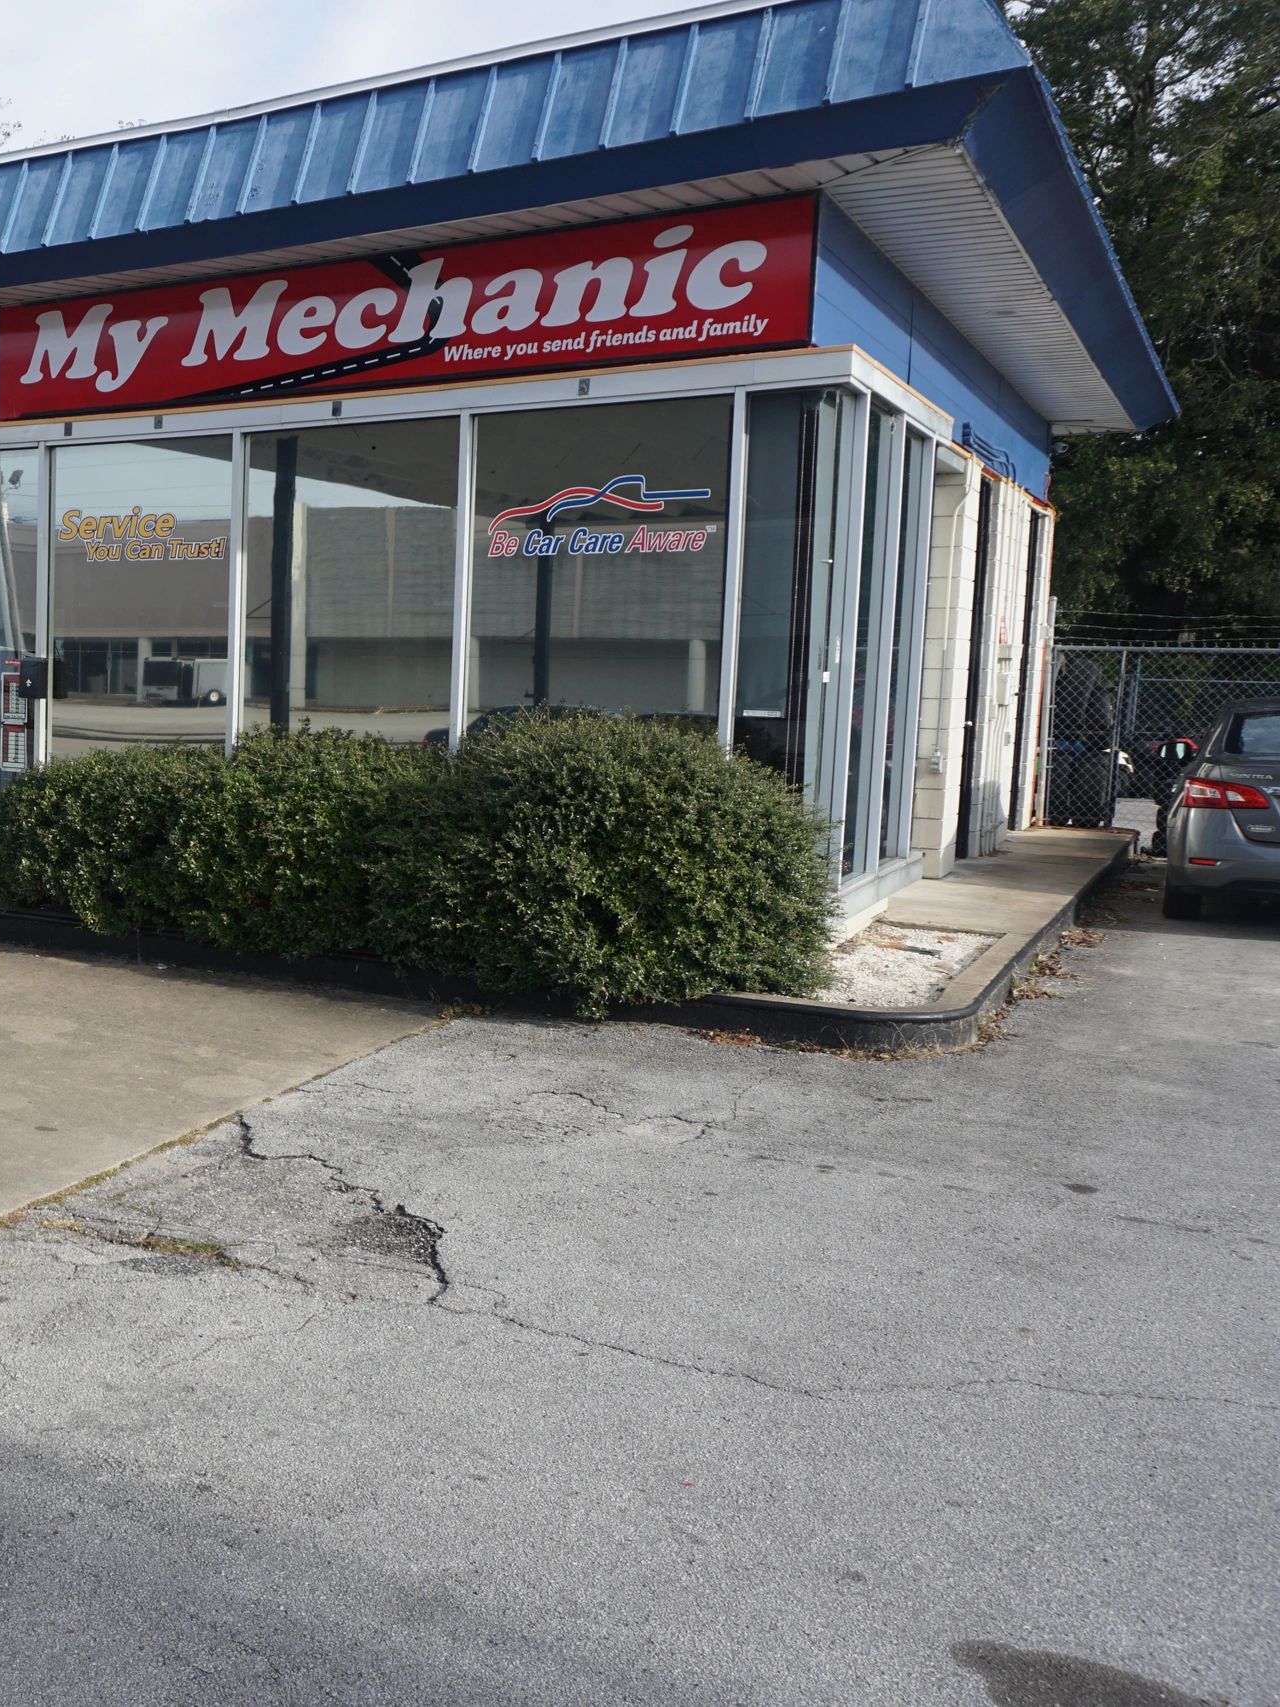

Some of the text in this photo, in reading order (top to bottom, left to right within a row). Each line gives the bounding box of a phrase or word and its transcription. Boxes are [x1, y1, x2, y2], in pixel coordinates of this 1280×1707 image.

[20, 225, 767, 393] My Mechanic
[443, 314, 769, 362] Where you send friends and family
[59, 506, 176, 541] Service
[488, 530, 519, 557] Be
[523, 528, 565, 556] Car
[568, 527, 624, 555] Care
[625, 525, 707, 553] Aware
[86, 537, 227, 561] You Can Trust!
